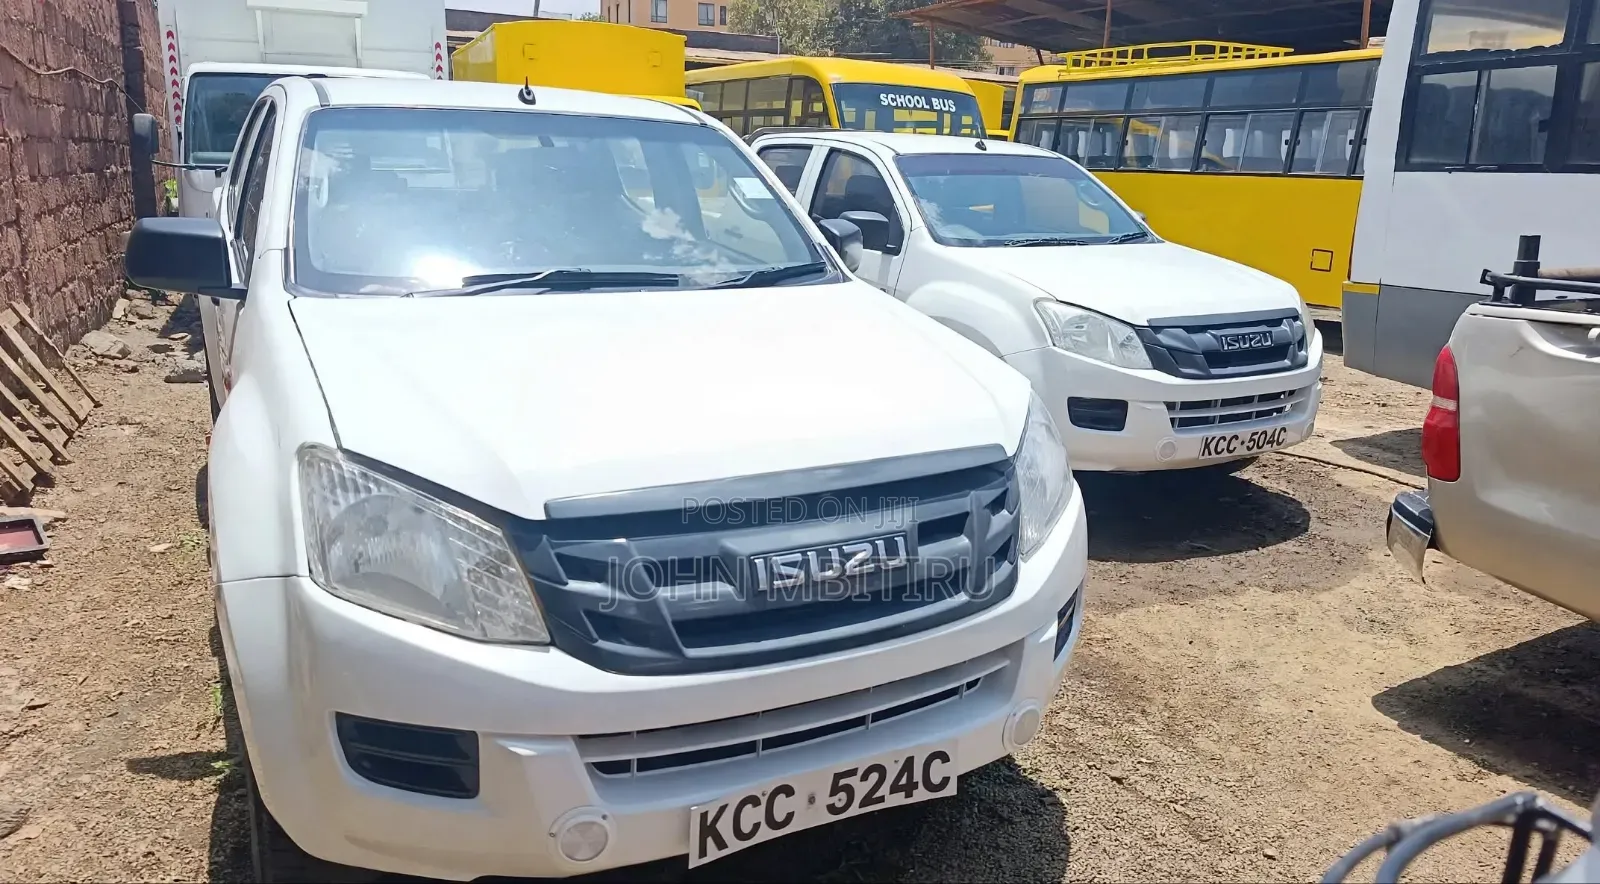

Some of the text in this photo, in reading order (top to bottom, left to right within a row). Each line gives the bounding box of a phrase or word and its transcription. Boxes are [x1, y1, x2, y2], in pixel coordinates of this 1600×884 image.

[880, 93, 956, 112] SCHOOL BUS
[1221, 333, 1273, 351] ISUZU
[752, 534, 908, 592] ISUZU
[698, 750, 951, 859] KCC 524C
